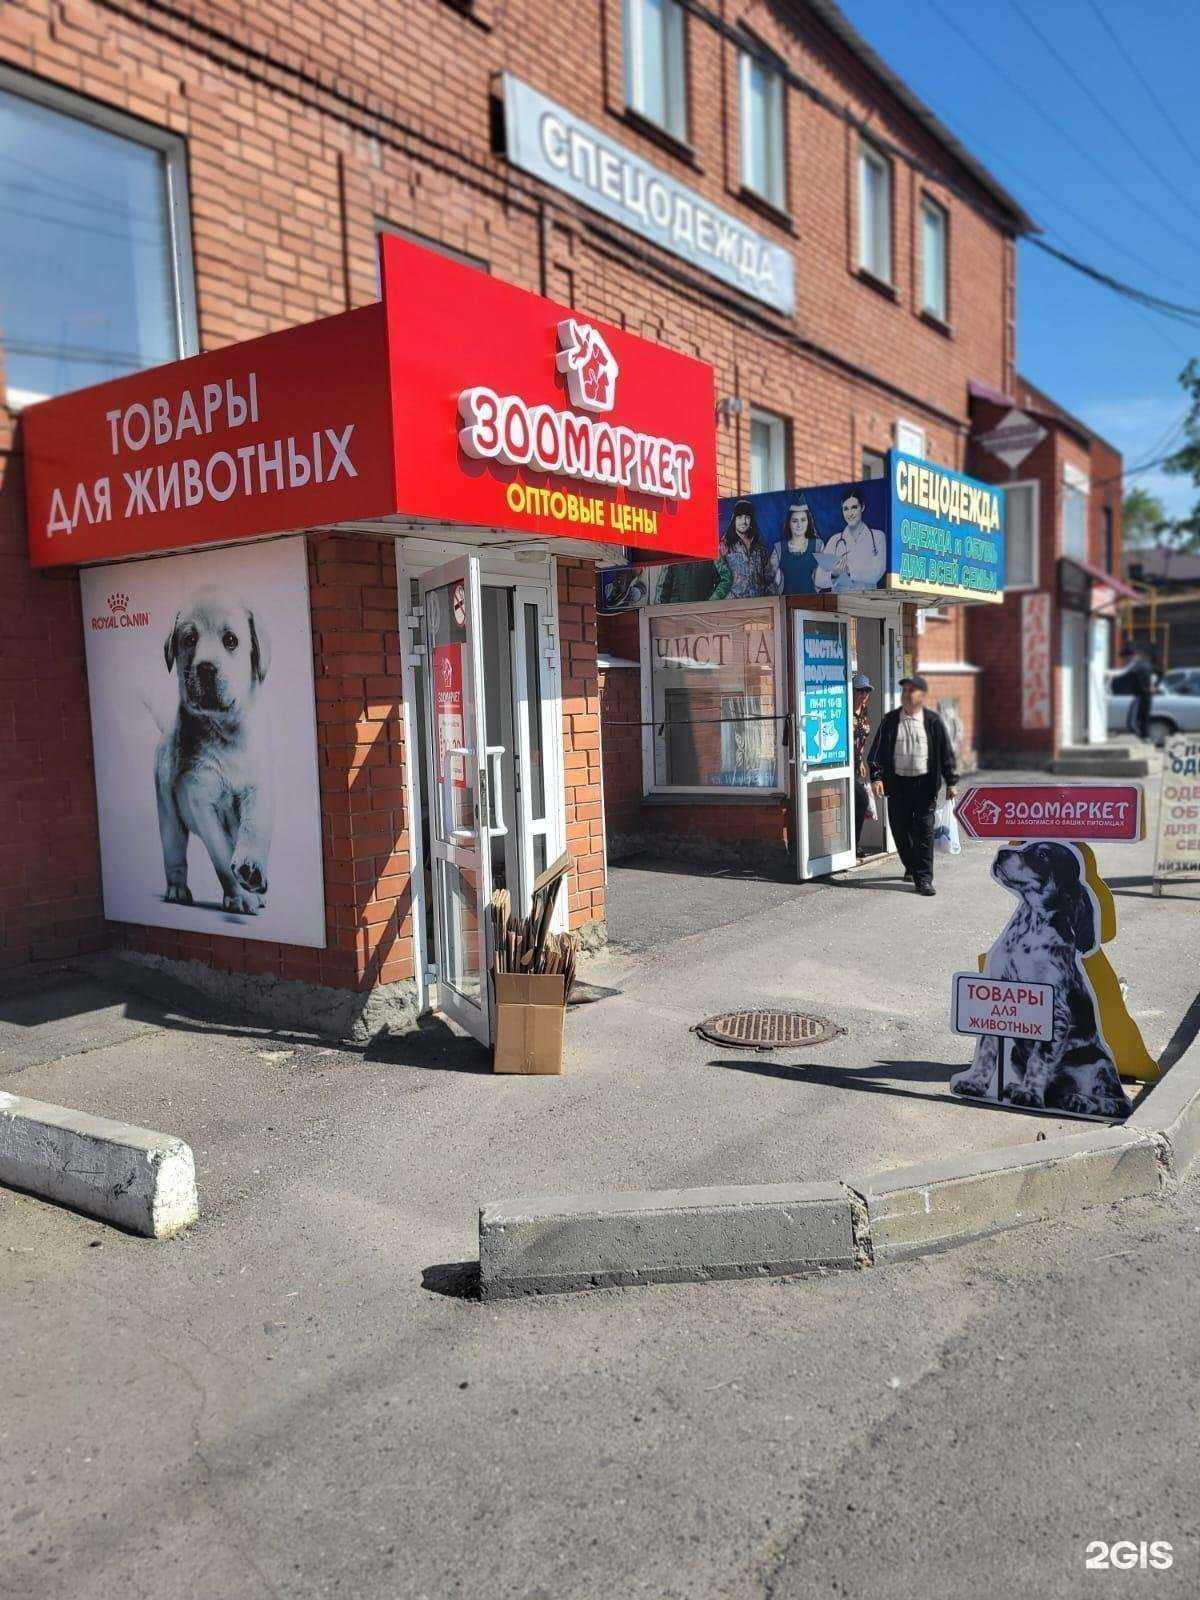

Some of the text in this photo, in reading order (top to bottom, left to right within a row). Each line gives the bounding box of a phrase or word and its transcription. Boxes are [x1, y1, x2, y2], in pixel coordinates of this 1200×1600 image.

[540, 112, 776, 291] СПЕЦОДЕЖДА
[106, 373, 259, 455] ТОВАРЫ
[468, 388, 694, 499] ЗООМАРКЕТ
[46, 424, 358, 538] ДЛЯ ЖИВОТНЫХ
[896, 460, 1000, 533] СПЕЦОДЕЖДА
[507, 483, 657, 535] ОПТОВЫЕ ЦЕНЫ
[901, 518, 953, 556] ОДЕЖДА
[900, 552, 926, 584] ДЛЯ
[929, 557, 960, 586] ВСЕЙ
[91, 612, 149, 631] ROYAL CANIN
[1004, 802, 1129, 819] ЗООМАРКЕТ
[967, 984, 1044, 1006] ТОВАРЫ
[991, 1005, 1017, 1017] ДЛЯ
[969, 1017, 1042, 1035] ЖИВОТНЫХ
